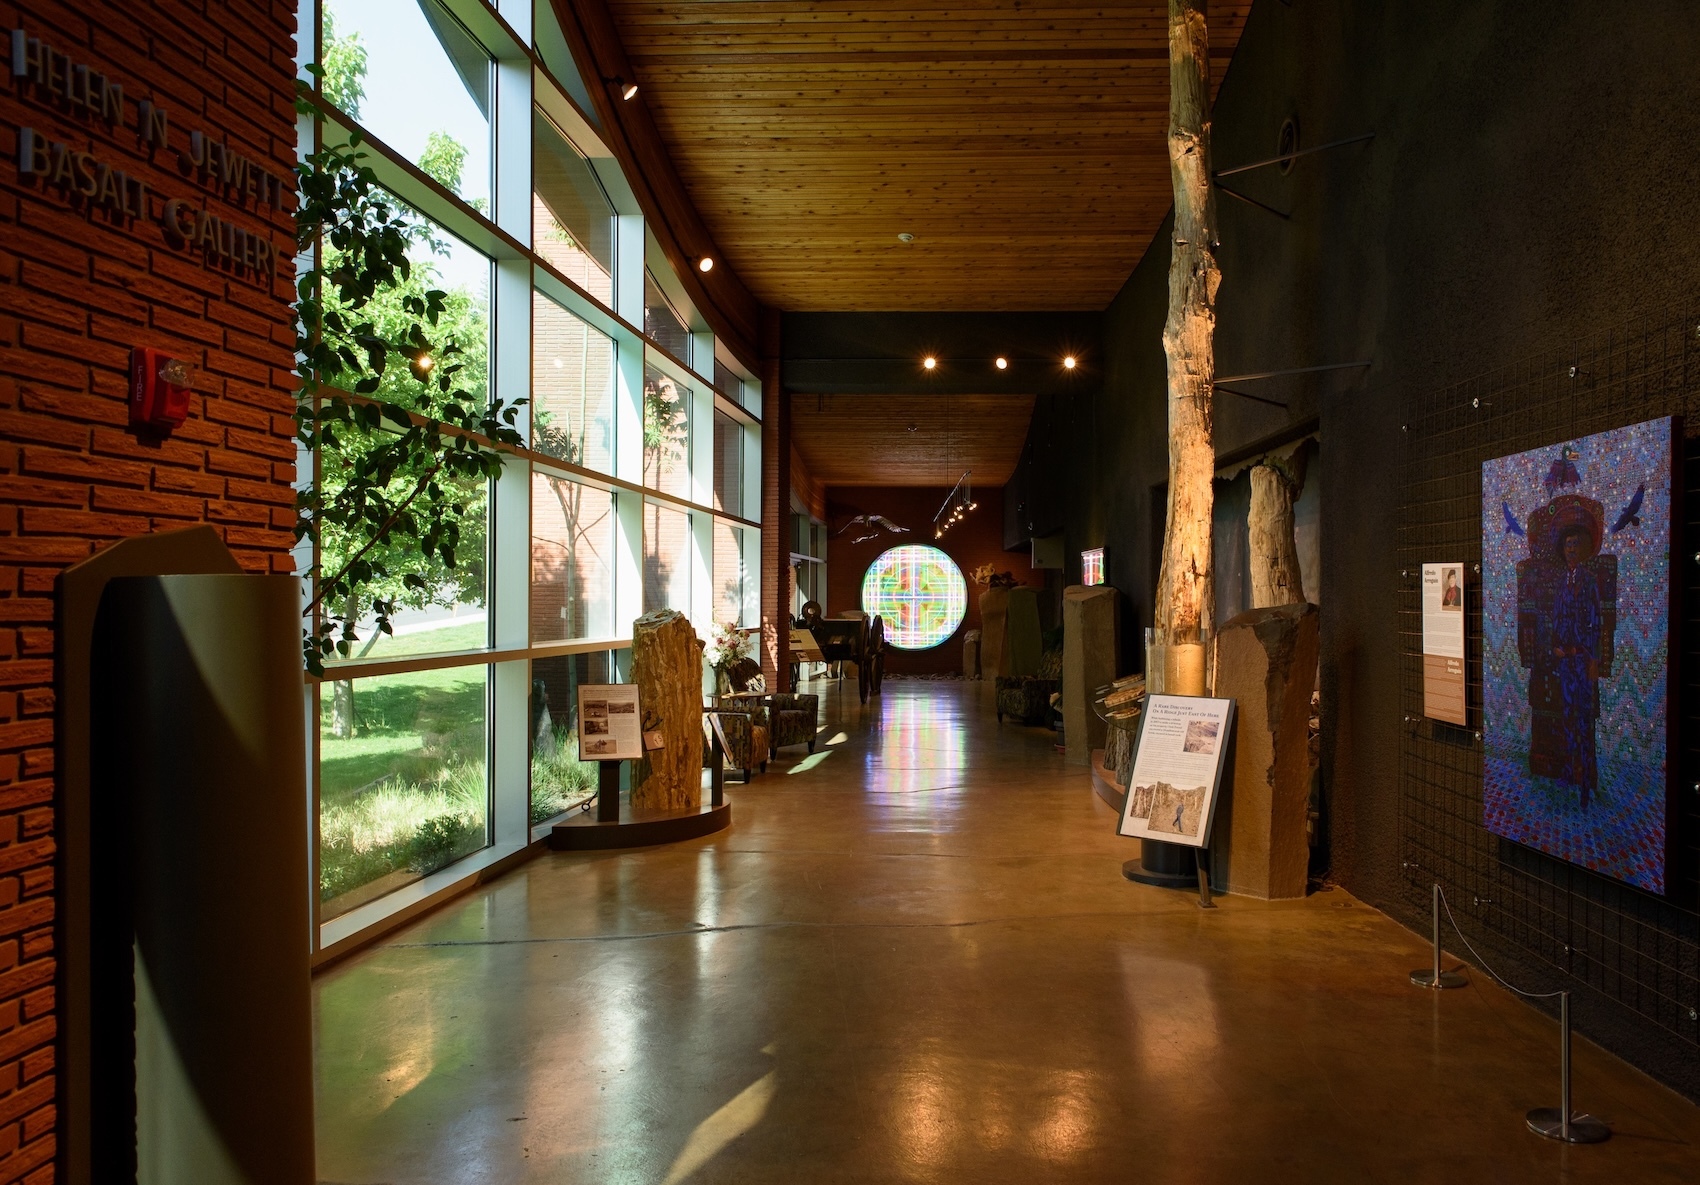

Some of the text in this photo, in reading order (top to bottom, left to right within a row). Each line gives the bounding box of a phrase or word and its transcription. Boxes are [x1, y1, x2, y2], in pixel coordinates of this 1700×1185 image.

[12, 29, 287, 210] HELEN N JEWETT
[20, 127, 281, 281] BASALT GALLERY
